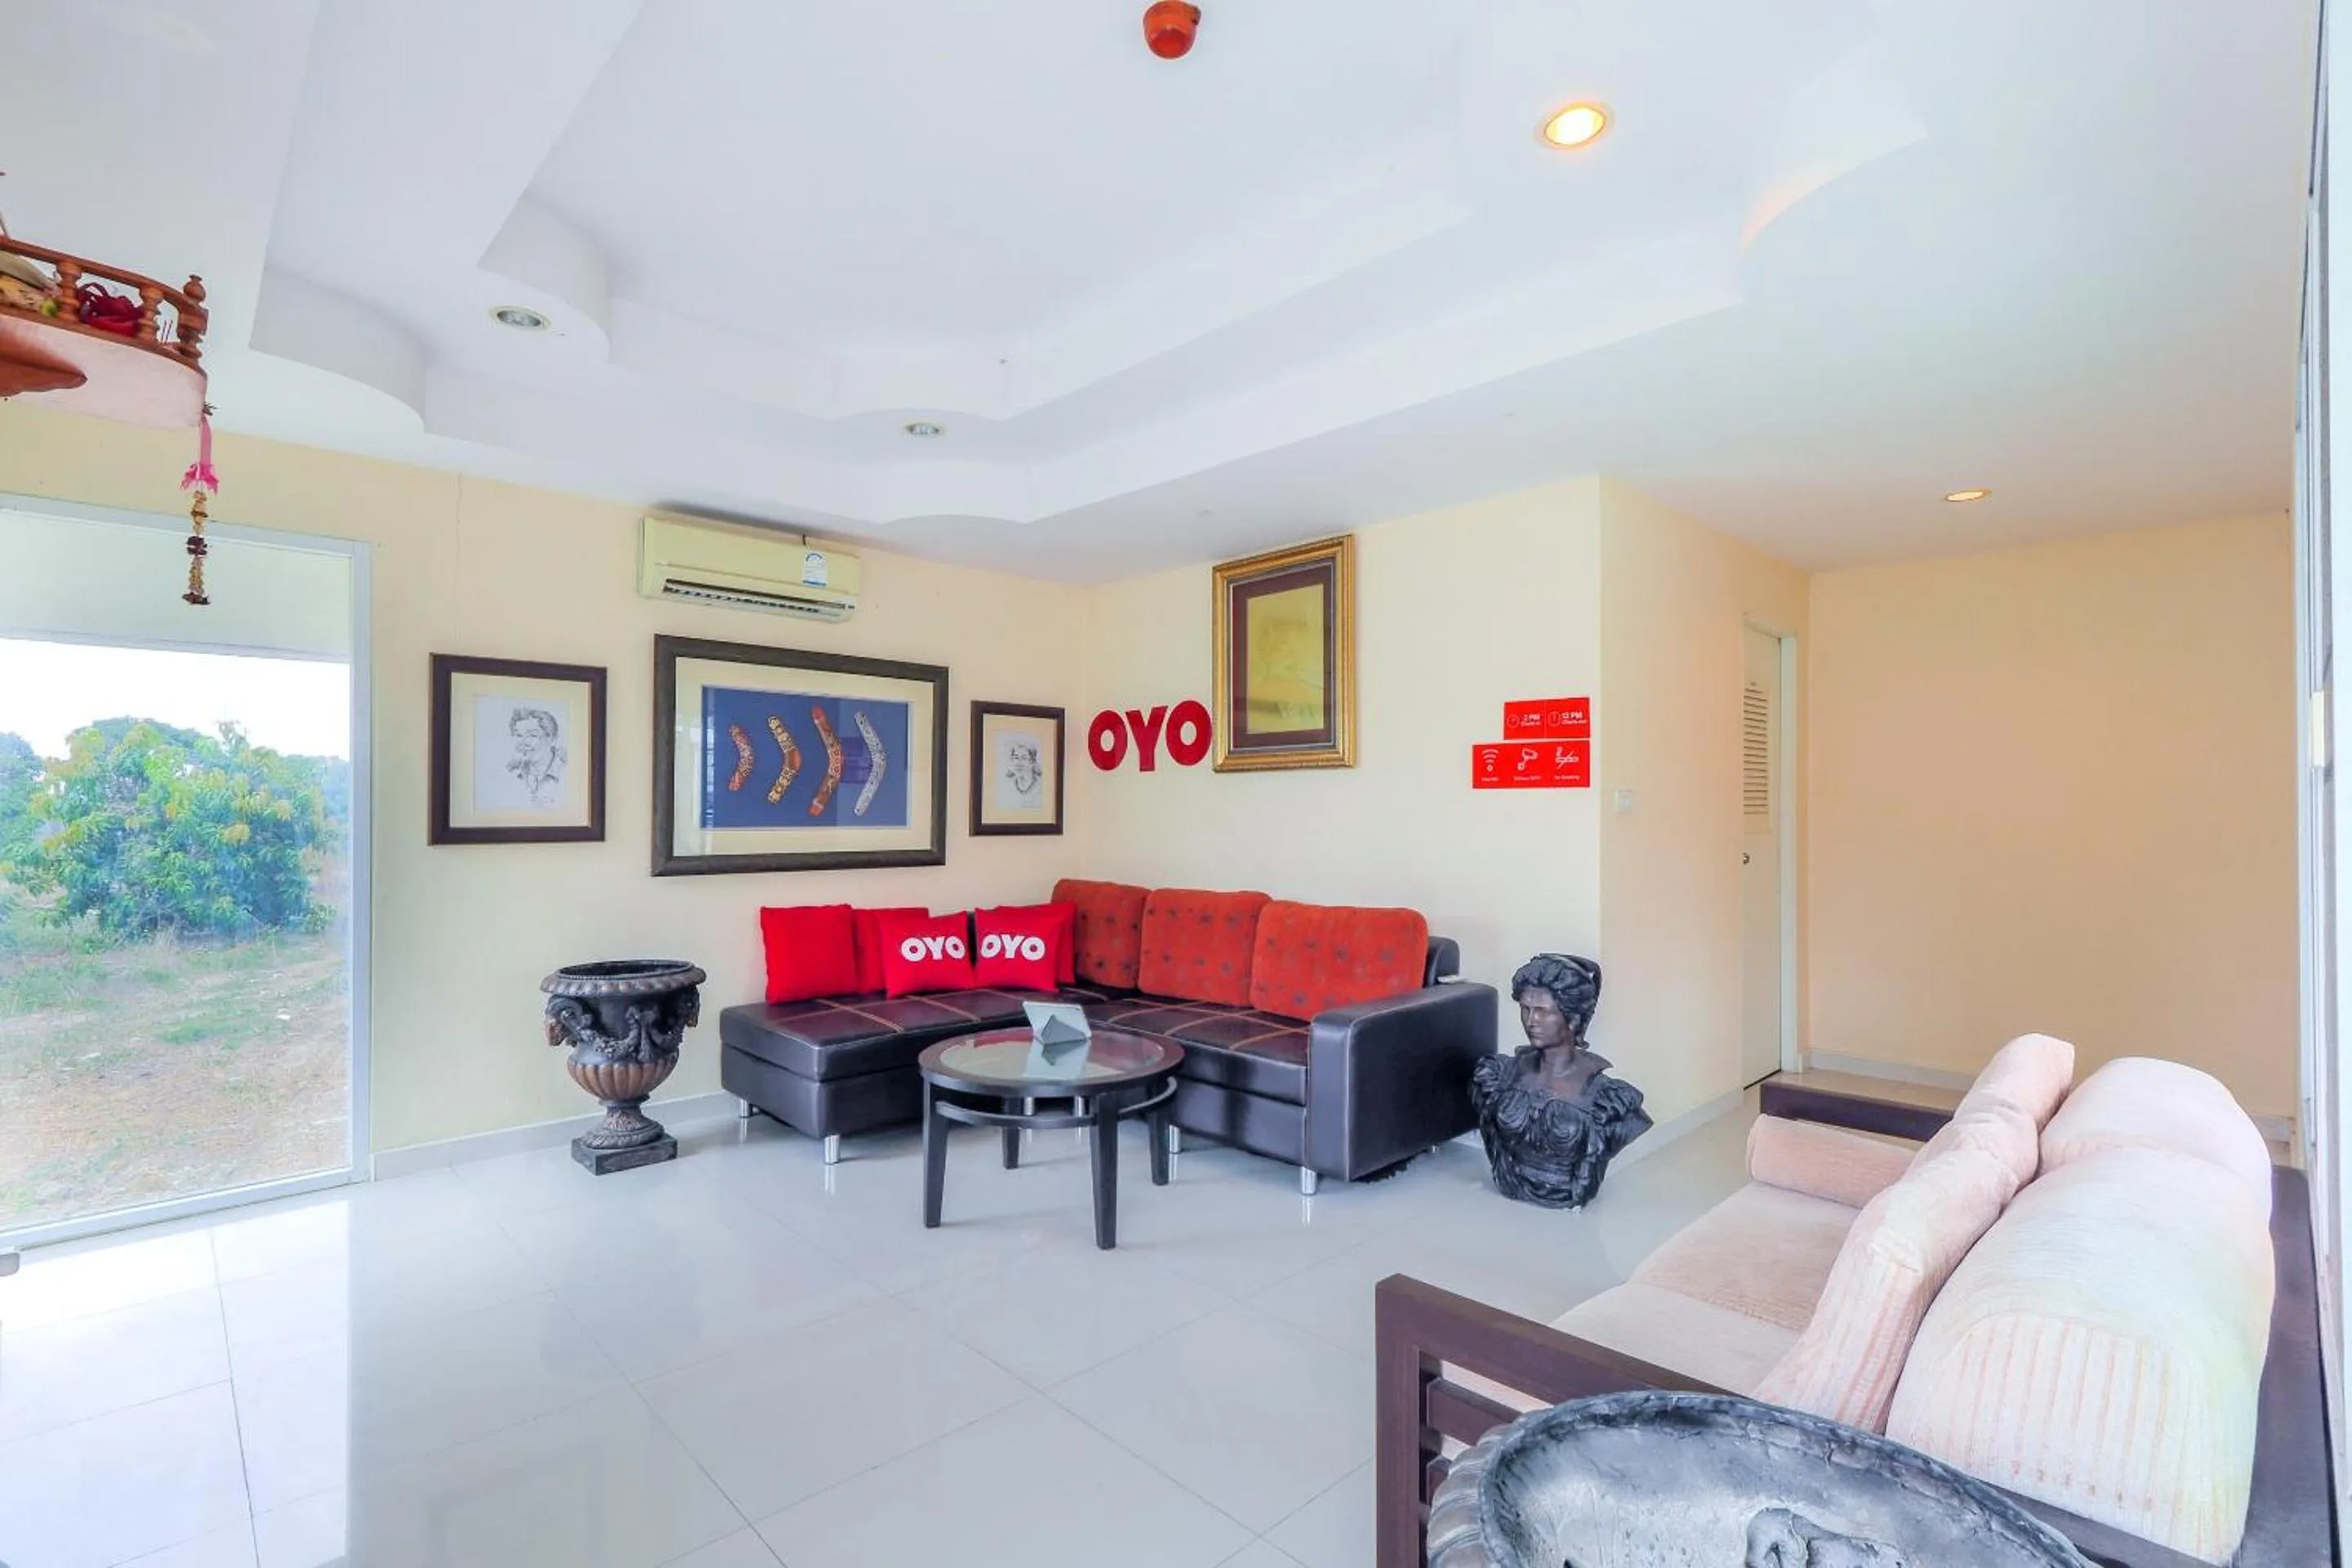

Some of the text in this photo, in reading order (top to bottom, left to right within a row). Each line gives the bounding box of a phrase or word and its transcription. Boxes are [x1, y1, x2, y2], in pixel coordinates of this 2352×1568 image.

[1088, 700, 1213, 772] OYO
[901, 936, 966, 962] OYO
[980, 934, 1046, 961] OYO
